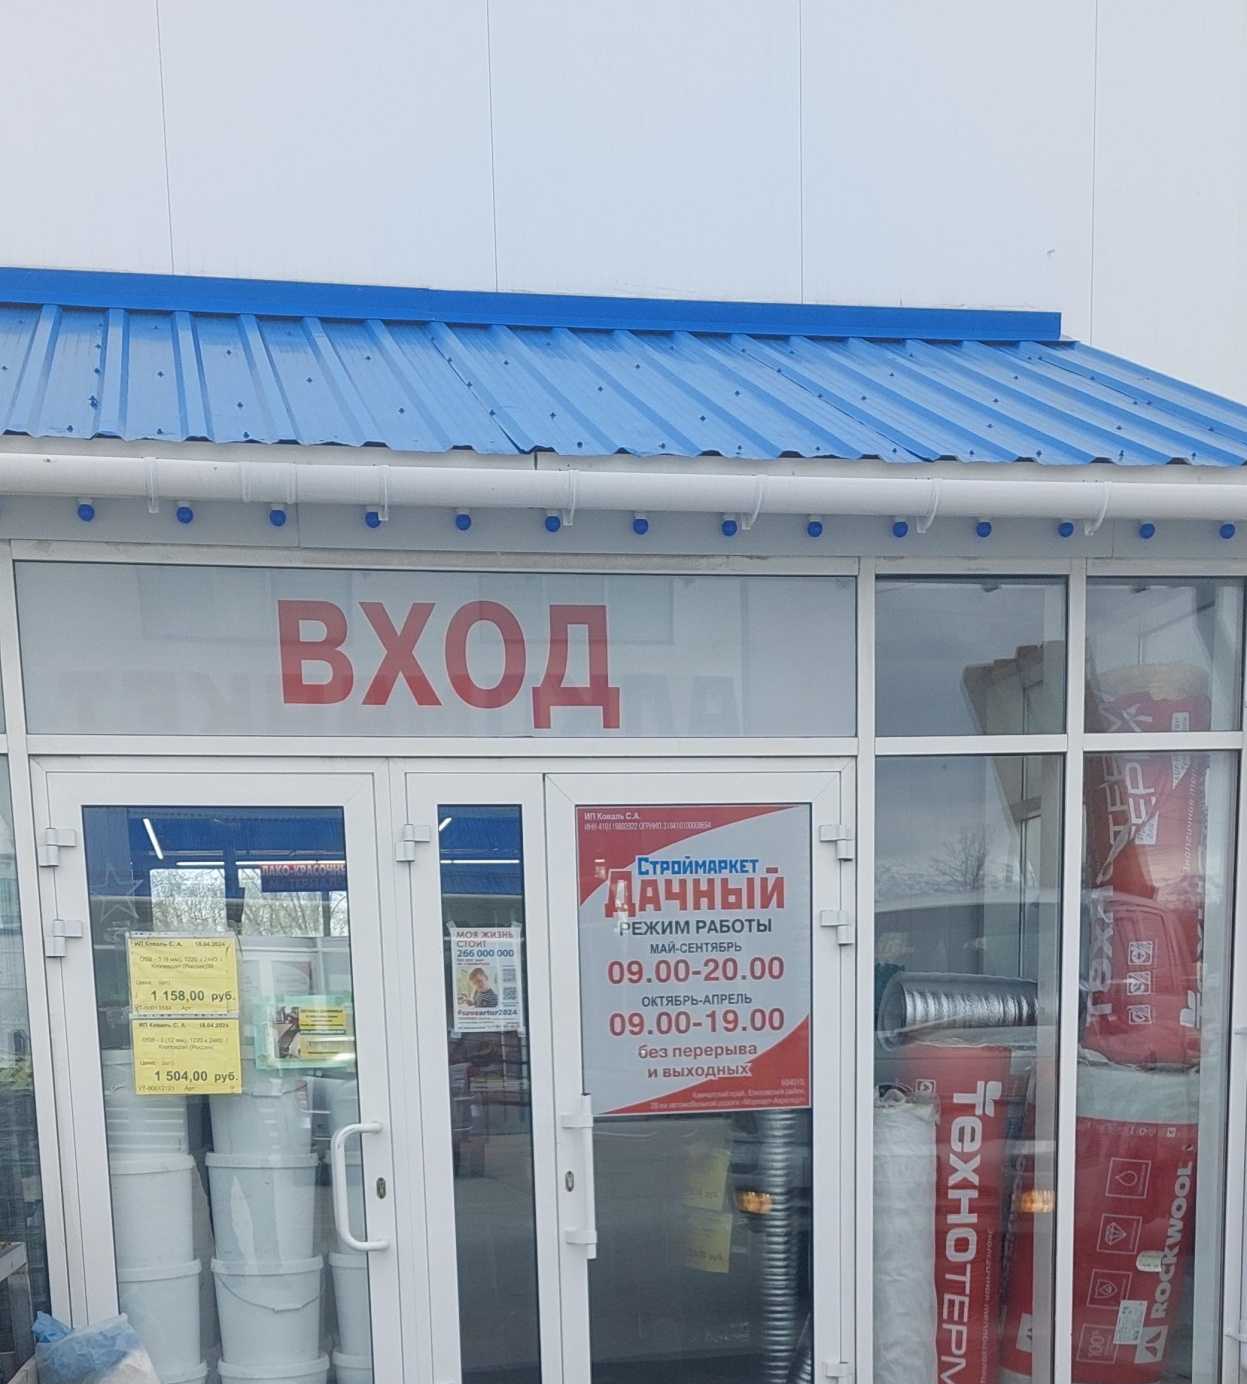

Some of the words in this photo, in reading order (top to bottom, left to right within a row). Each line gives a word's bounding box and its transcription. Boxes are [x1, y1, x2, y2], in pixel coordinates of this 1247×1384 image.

[277, 599, 621, 729] ВХОД
[584, 812, 596, 820] ИП
[604, 867, 784, 918] ДАЧНЫЙ
[619, 920, 690, 936] РЕЖИМ
[695, 918, 772, 934] РАБОТЫ
[457, 931, 478, 939] МОЯ
[457, 949, 475, 957] 266
[477, 949, 494, 957] 000
[497, 949, 514, 957] 000
[650, 940, 742, 954] МАЙ-СЕНТЯБРЬ
[607, 956, 785, 985] 09.00-20.00
[151, 990, 157, 1001] 1
[163, 990, 205, 1002] 158,00
[211, 991, 236, 1002] руб.
[642, 993, 752, 1008] ОКТЯБРЬ-АПРЕЛЬ
[609, 1007, 785, 1036] 09.00-19.00
[639, 1044, 668, 1059] без
[673, 1044, 757, 1060] перерыва
[155, 1071, 160, 1081] 1
[166, 1071, 208, 1082] 504,00
[214, 1072, 238, 1083] руб.
[648, 1068, 658, 1078] и
[663, 1065, 750, 1080] выходных
[1151, 1161, 1192, 1318] ROCKWOOL
